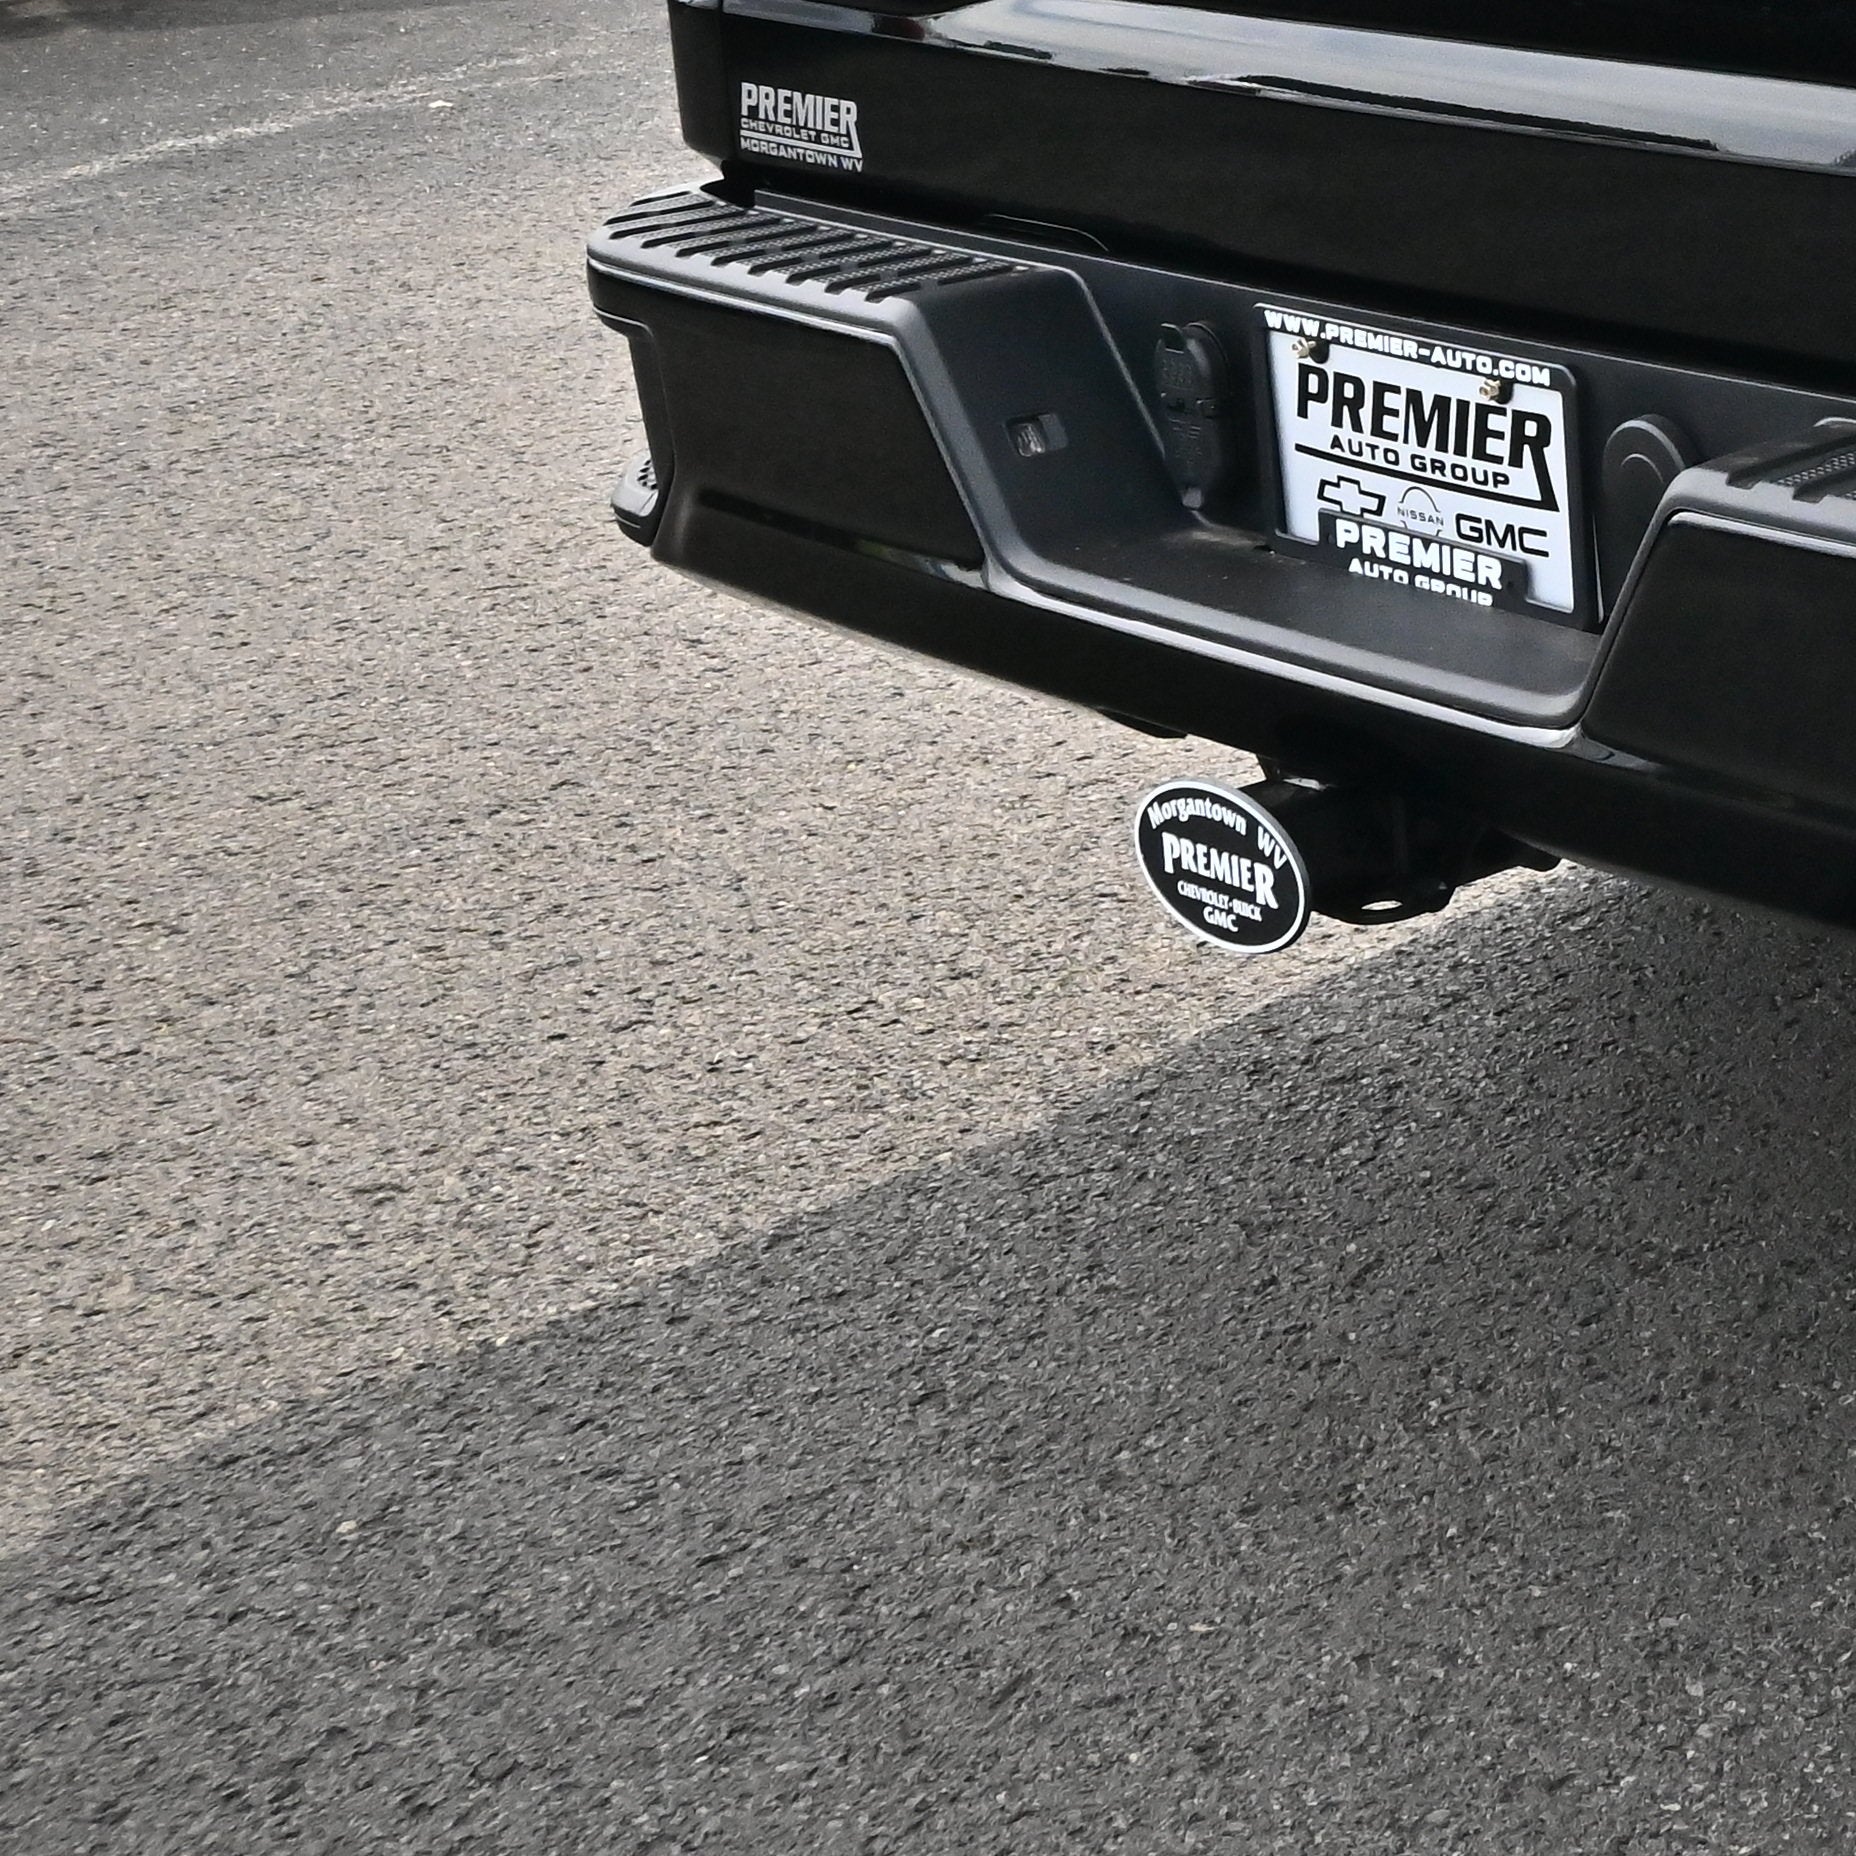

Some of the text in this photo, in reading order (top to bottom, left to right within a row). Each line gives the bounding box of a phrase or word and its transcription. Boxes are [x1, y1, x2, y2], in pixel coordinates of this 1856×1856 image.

[741, 83, 860, 147] PREMIER
[741, 118, 850, 147] CHEVROLET GMC
[740, 137, 863, 172] MORGANTOWN WV
[1264, 309, 1552, 386] WWW.PREMIER-AUTO.COM
[1295, 363, 1556, 489] PREMIER
[1330, 436, 1511, 490] AUTO GROUP
[1397, 506, 1445, 527] NISSAN
[1455, 513, 1550, 558] GMC
[1335, 518, 1503, 590] PREMIER
[1348, 557, 1409, 584] AUTO
[1147, 797, 1288, 870] Morgantown WV
[1161, 832, 1278, 910] PREMIER
[1203, 907, 1239, 932] GMC
